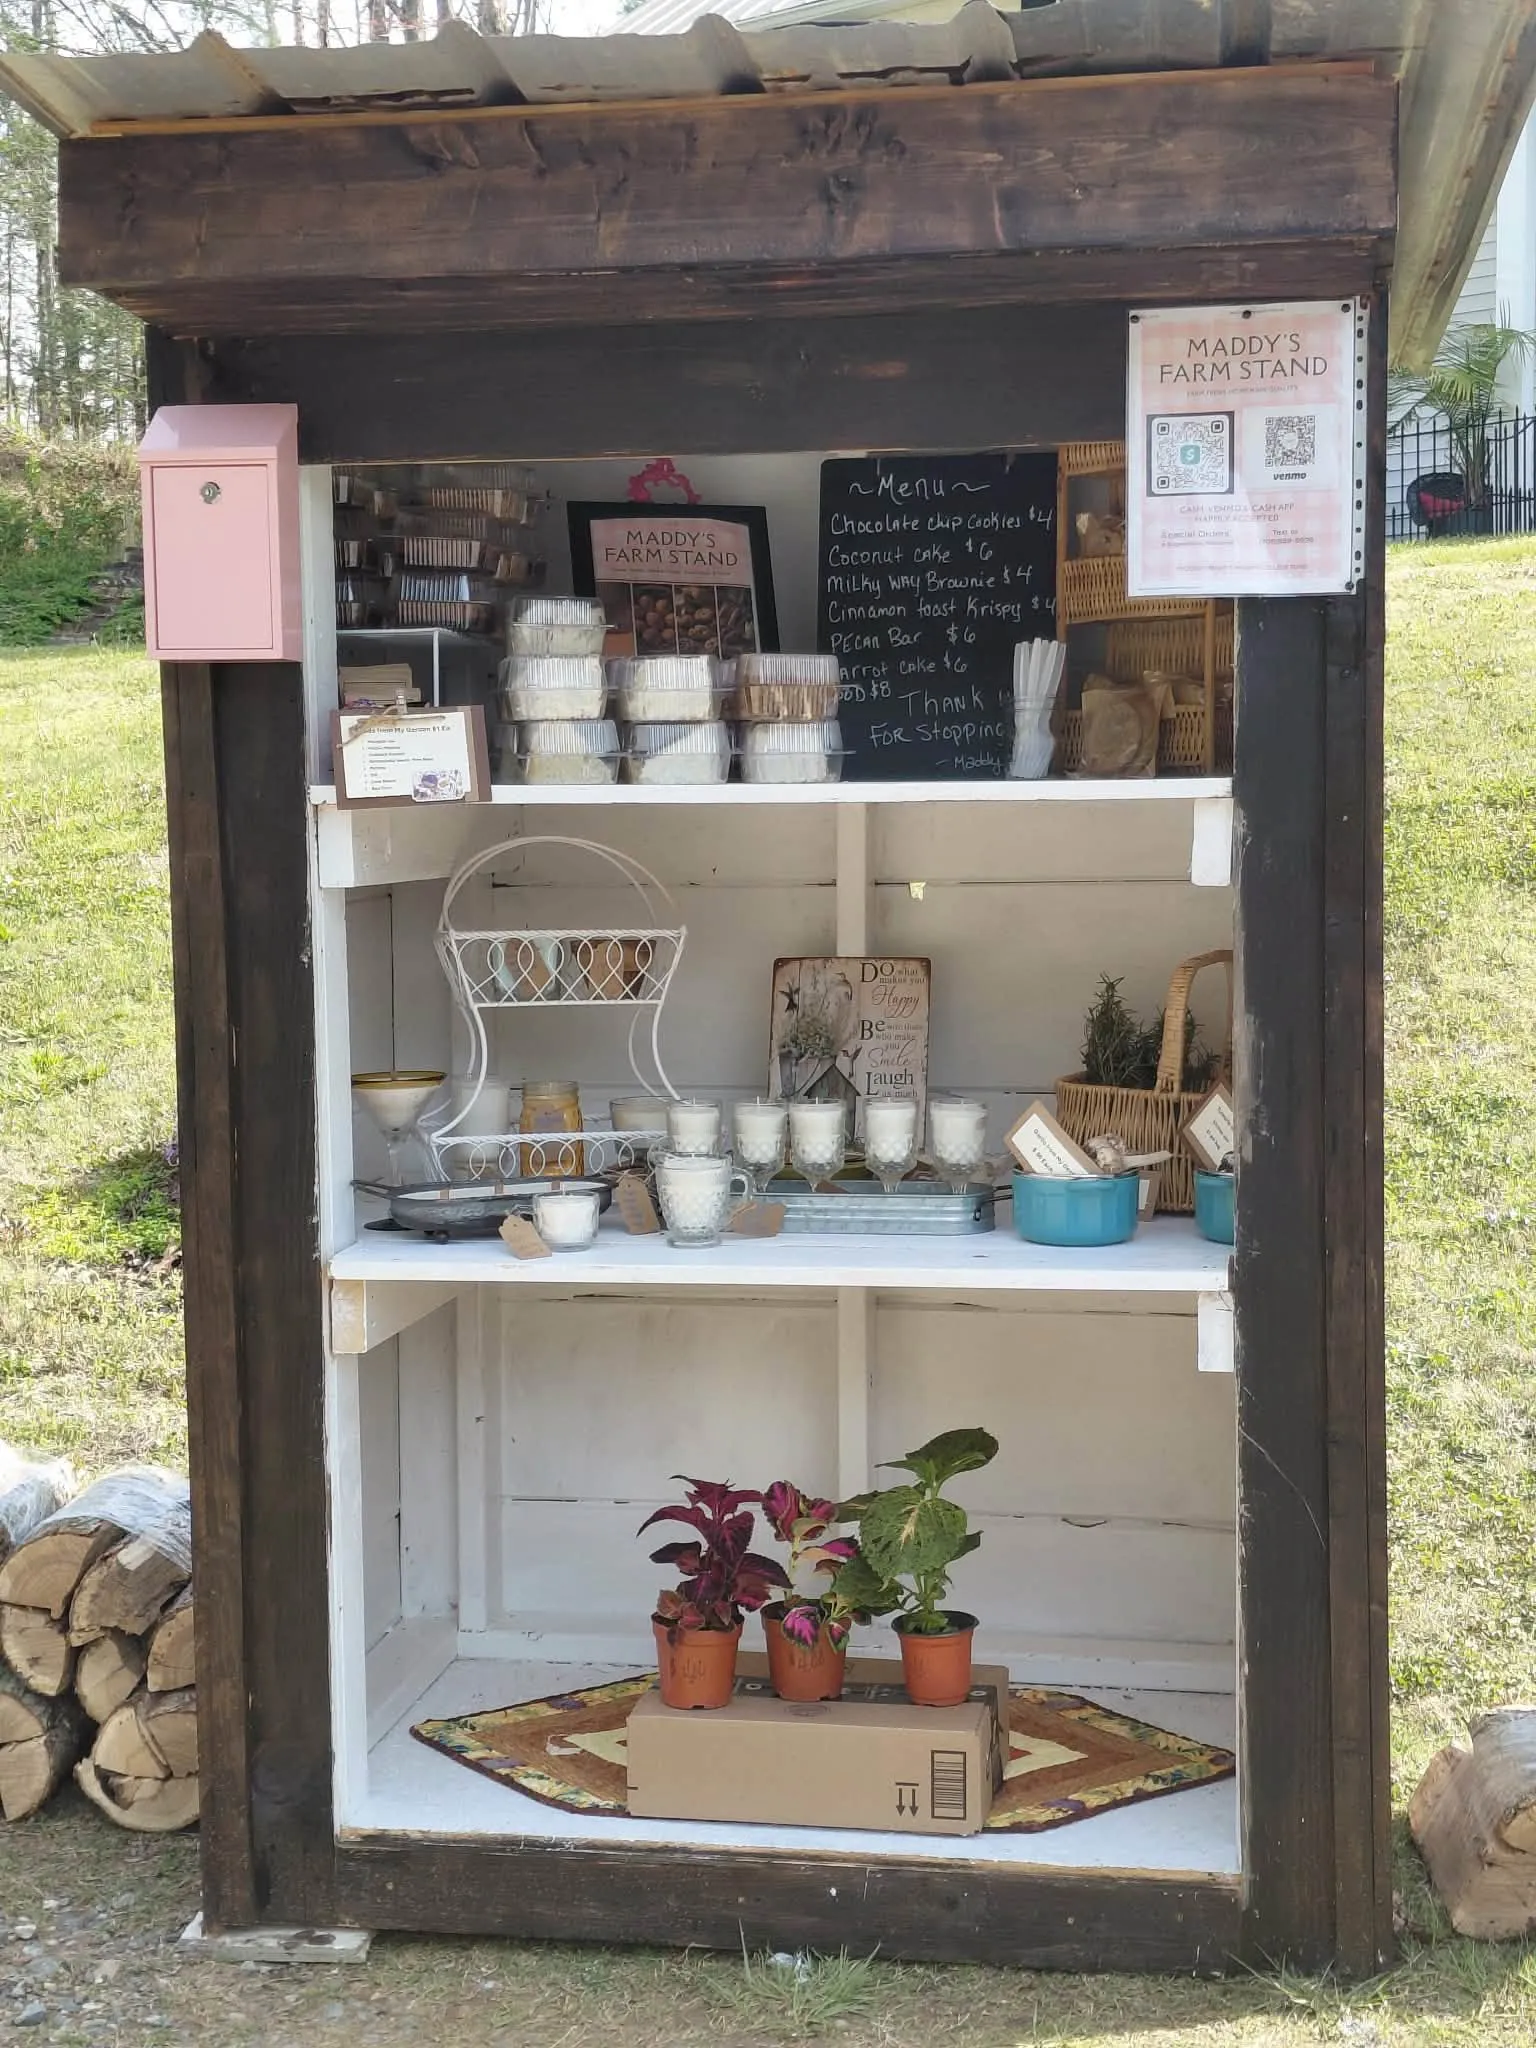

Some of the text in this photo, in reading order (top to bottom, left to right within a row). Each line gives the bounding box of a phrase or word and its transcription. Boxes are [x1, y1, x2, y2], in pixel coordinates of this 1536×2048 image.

[1187, 333, 1301, 358] MADDY'S
[1160, 356, 1328, 383] FARM STAND
[1273, 472, 1307, 481] venmo
[831, 512, 920, 535] Chocolate
[927, 513, 963, 532] chip
[1029, 504, 1053, 530] $4
[1252, 503, 1276, 512] CASH
[626, 530, 716, 548] MADDY'S
[605, 547, 738, 566] FARM STAND
[828, 544, 903, 567] Coconut
[965, 537, 993, 561] $6
[927, 571, 996, 592] Brownie
[1003, 565, 1033, 585] $4
[828, 595, 1057, 623] Cinnamon toast Krispy $4
[888, 627, 923, 647] Bar
[946, 622, 976, 644] $6
[944, 651, 968, 673] $6
[870, 680, 891, 700] $8
[861, 962, 894, 982] Do
[871, 984, 920, 1019] Happy
[860, 1019, 886, 1041] Be
[868, 1038, 917, 1068] Smile
[864, 1068, 914, 1096] Laugh
